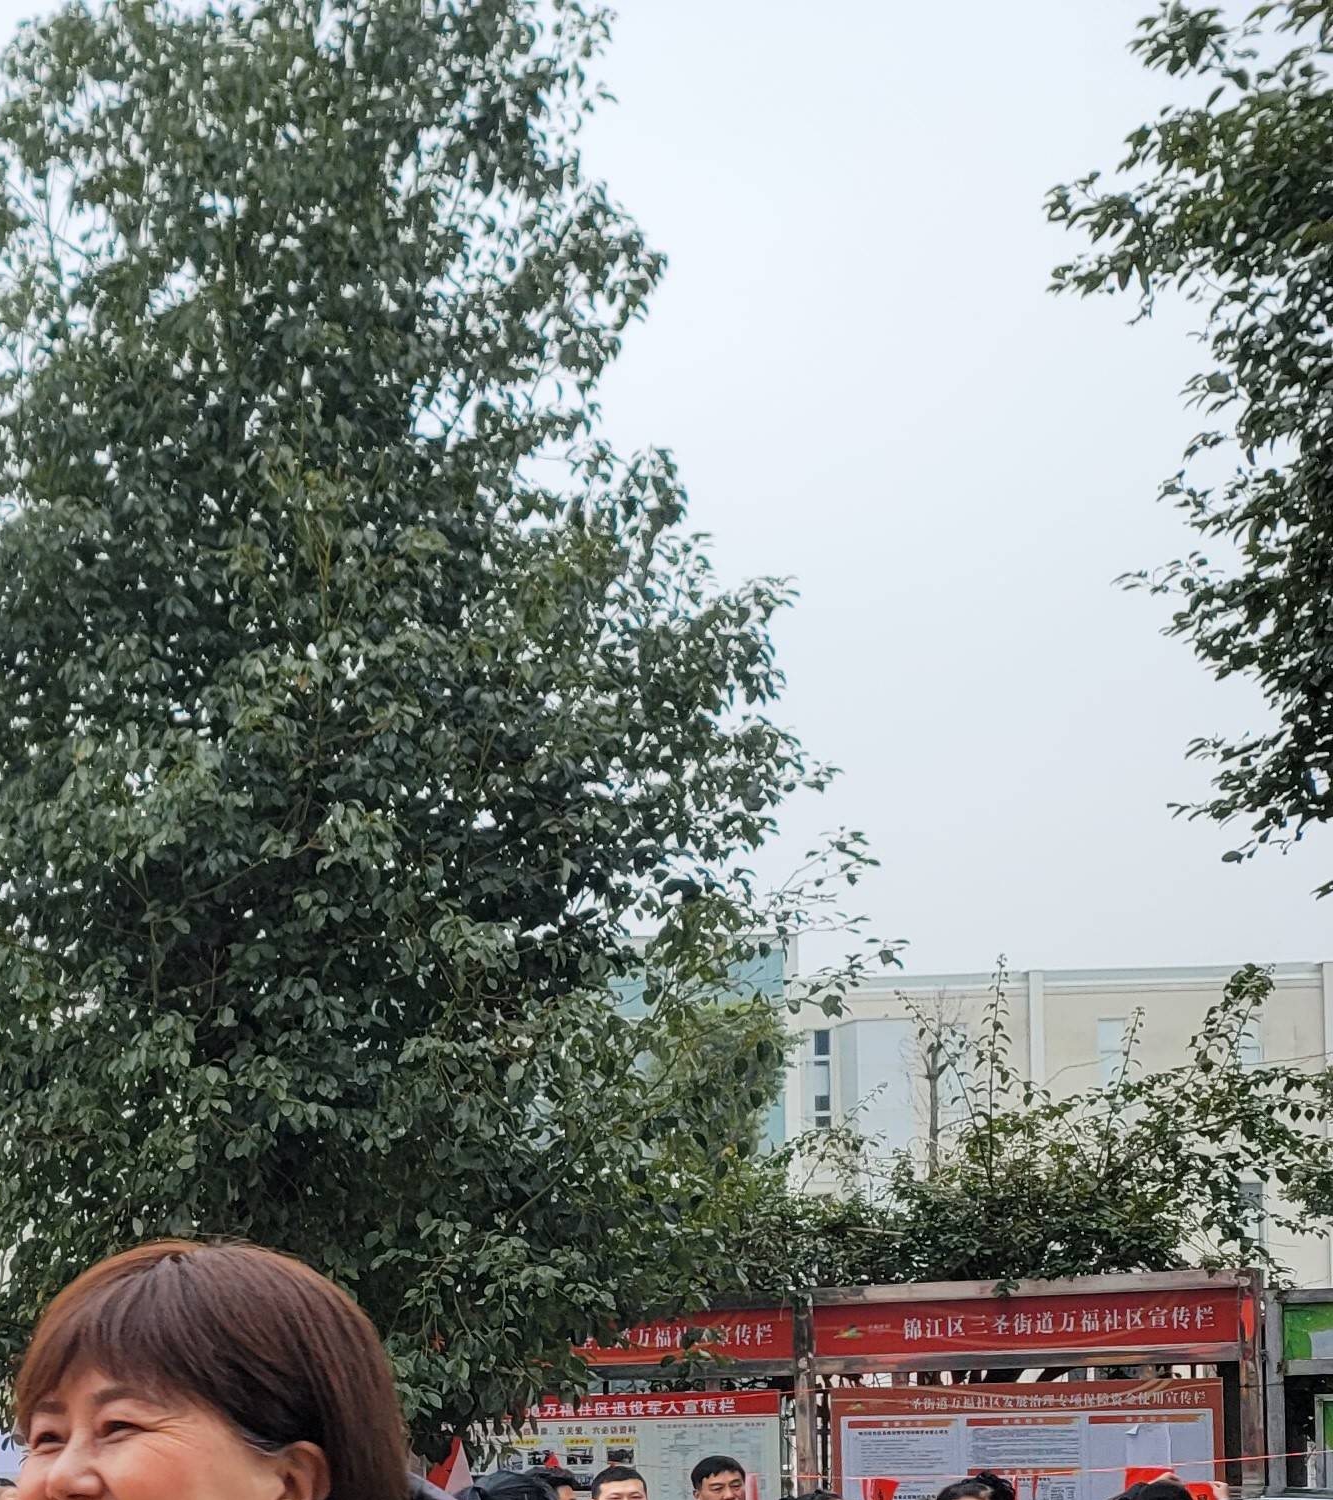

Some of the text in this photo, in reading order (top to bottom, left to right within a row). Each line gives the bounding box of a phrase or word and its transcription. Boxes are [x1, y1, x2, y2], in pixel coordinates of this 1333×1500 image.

[903, 1306, 1215, 1341] 锦江区三圣街道万福社区宣传栏
